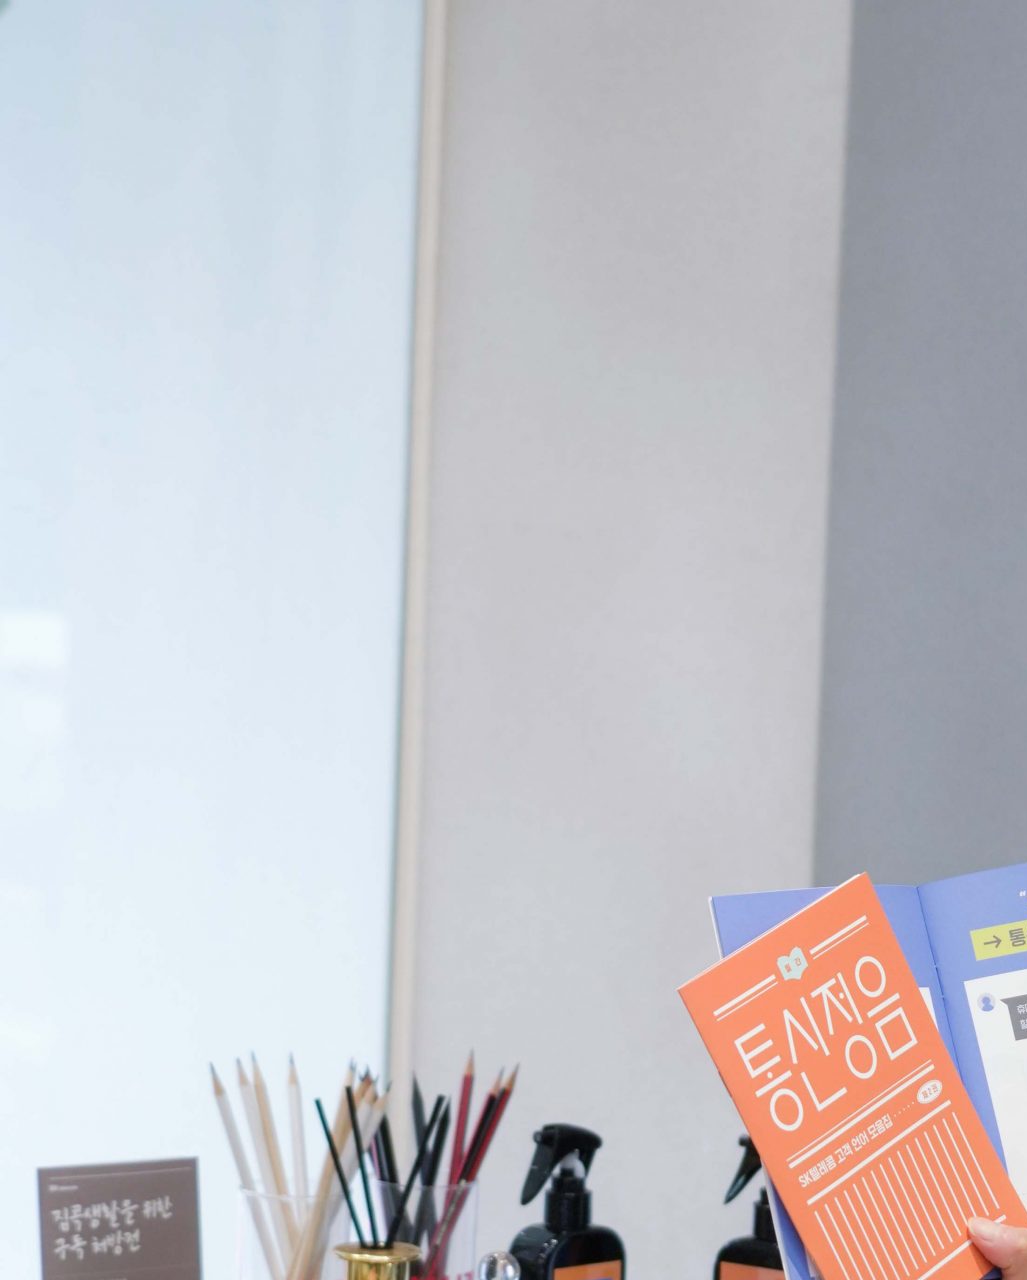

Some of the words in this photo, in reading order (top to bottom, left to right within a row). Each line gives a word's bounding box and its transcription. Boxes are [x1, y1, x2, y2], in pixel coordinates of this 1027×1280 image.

[734, 955, 918, 1132] 통신정음
[798, 1154, 837, 1188] SK텔레콤
[834, 1142, 854, 1164] 고객
[851, 1131, 869, 1152] 언어
[867, 1113, 893, 1139] 모음집
[143, 1196, 173, 1219] 위한
[54, 1234, 87, 1260] 구독
[91, 1229, 141, 1255] 처방전
